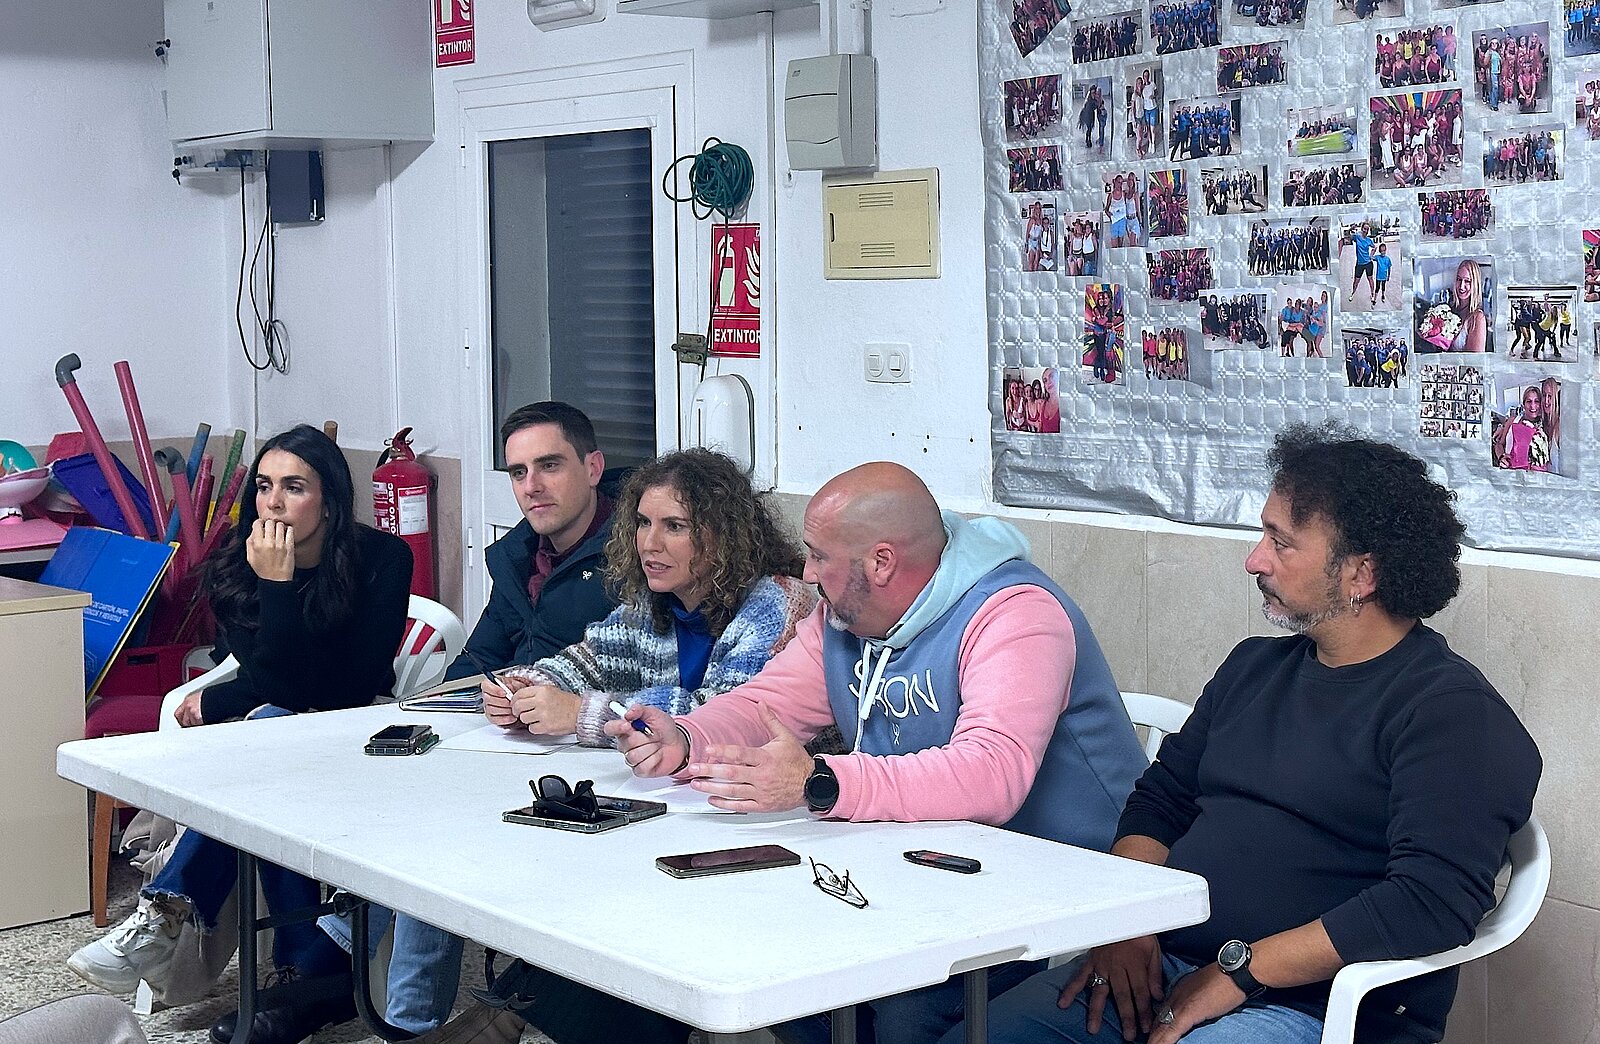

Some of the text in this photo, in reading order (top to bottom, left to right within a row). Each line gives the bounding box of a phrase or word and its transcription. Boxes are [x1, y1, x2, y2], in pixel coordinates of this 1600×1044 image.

[438, 39, 472, 56] EXTINTOR
[713, 327, 761, 345] EXTINTOR
[389, 506, 397, 535] OLVO
